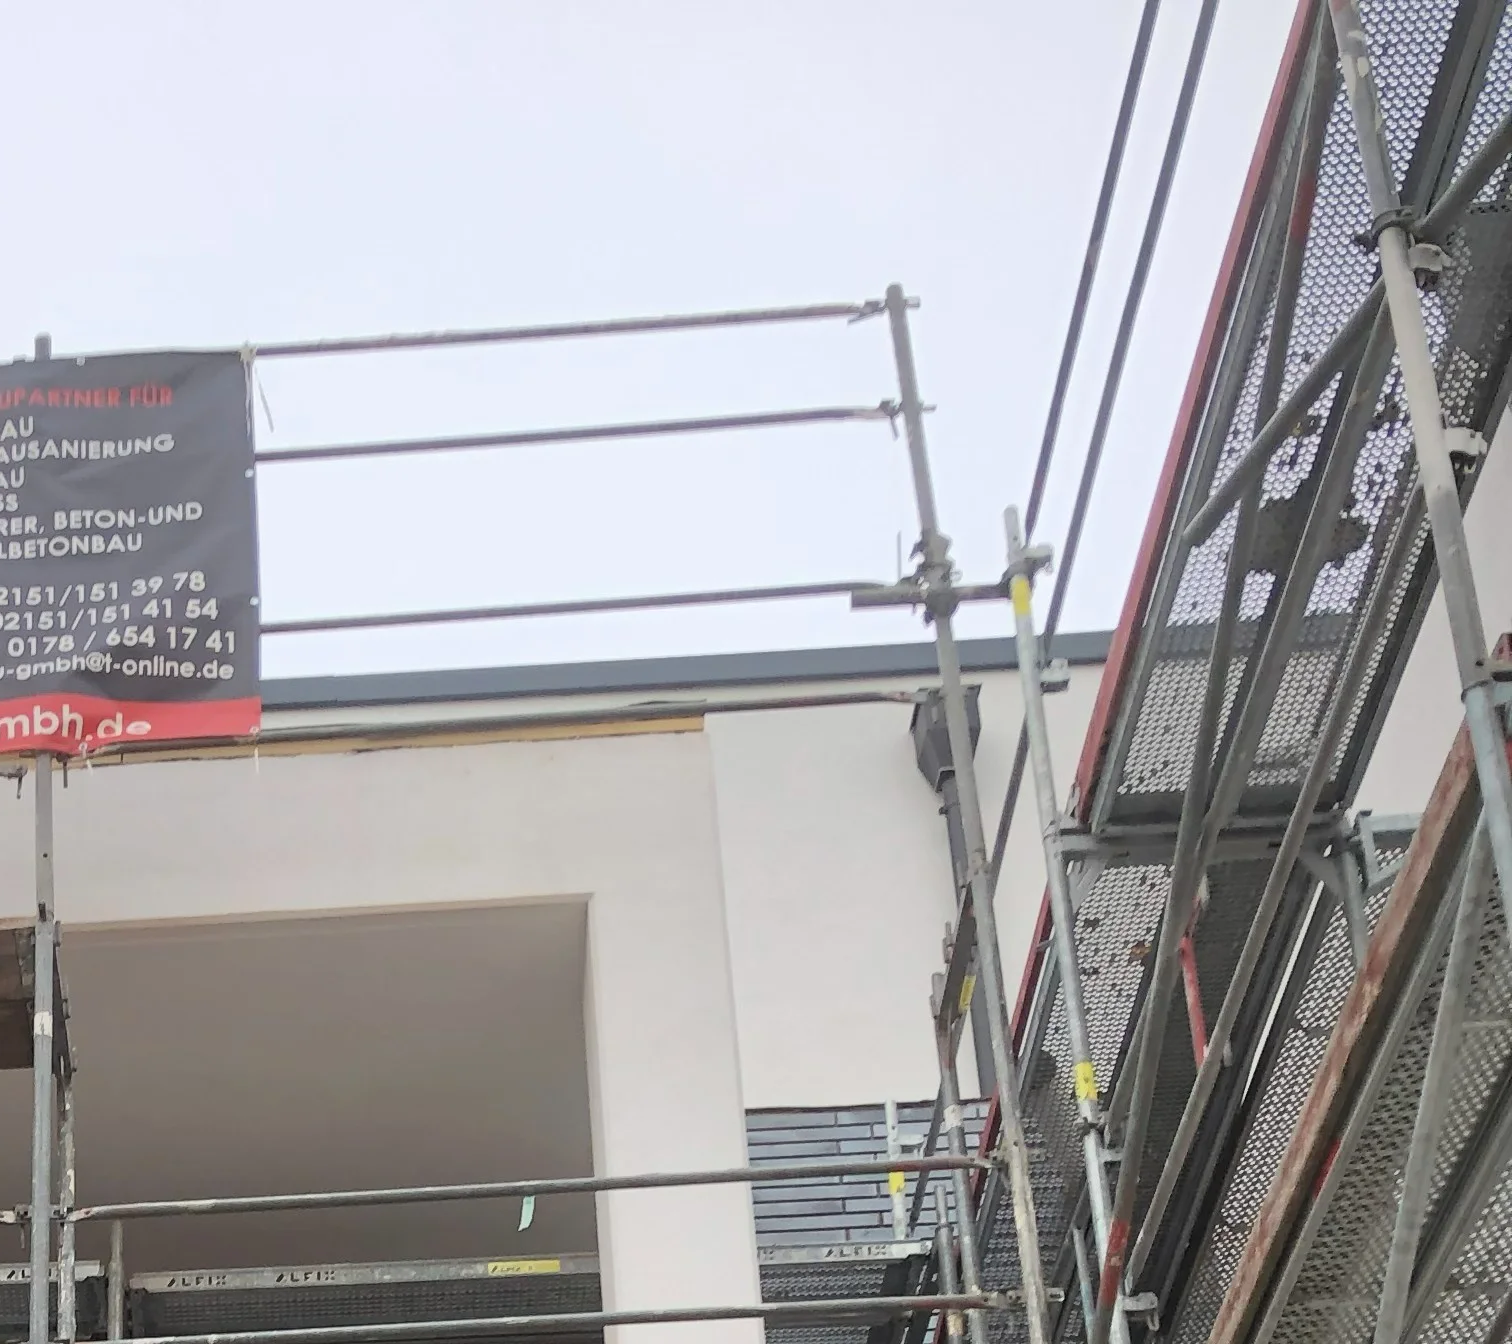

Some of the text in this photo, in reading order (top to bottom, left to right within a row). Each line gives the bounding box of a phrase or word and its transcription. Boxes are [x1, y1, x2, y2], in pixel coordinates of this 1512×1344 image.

[129, 381, 174, 408] FÜR
[53, 501, 204, 531] BETON-UND
[131, 576, 164, 597] 39
[172, 570, 206, 592] 78
[142, 598, 173, 619] 41
[184, 597, 219, 620] 54
[7, 634, 75, 658] 0178
[105, 626, 156, 648] 654
[165, 626, 198, 651] 17
[204, 630, 236, 654] 41
[167, 1275, 227, 1288] ALFIX
[275, 1270, 336, 1283] ALFIX
